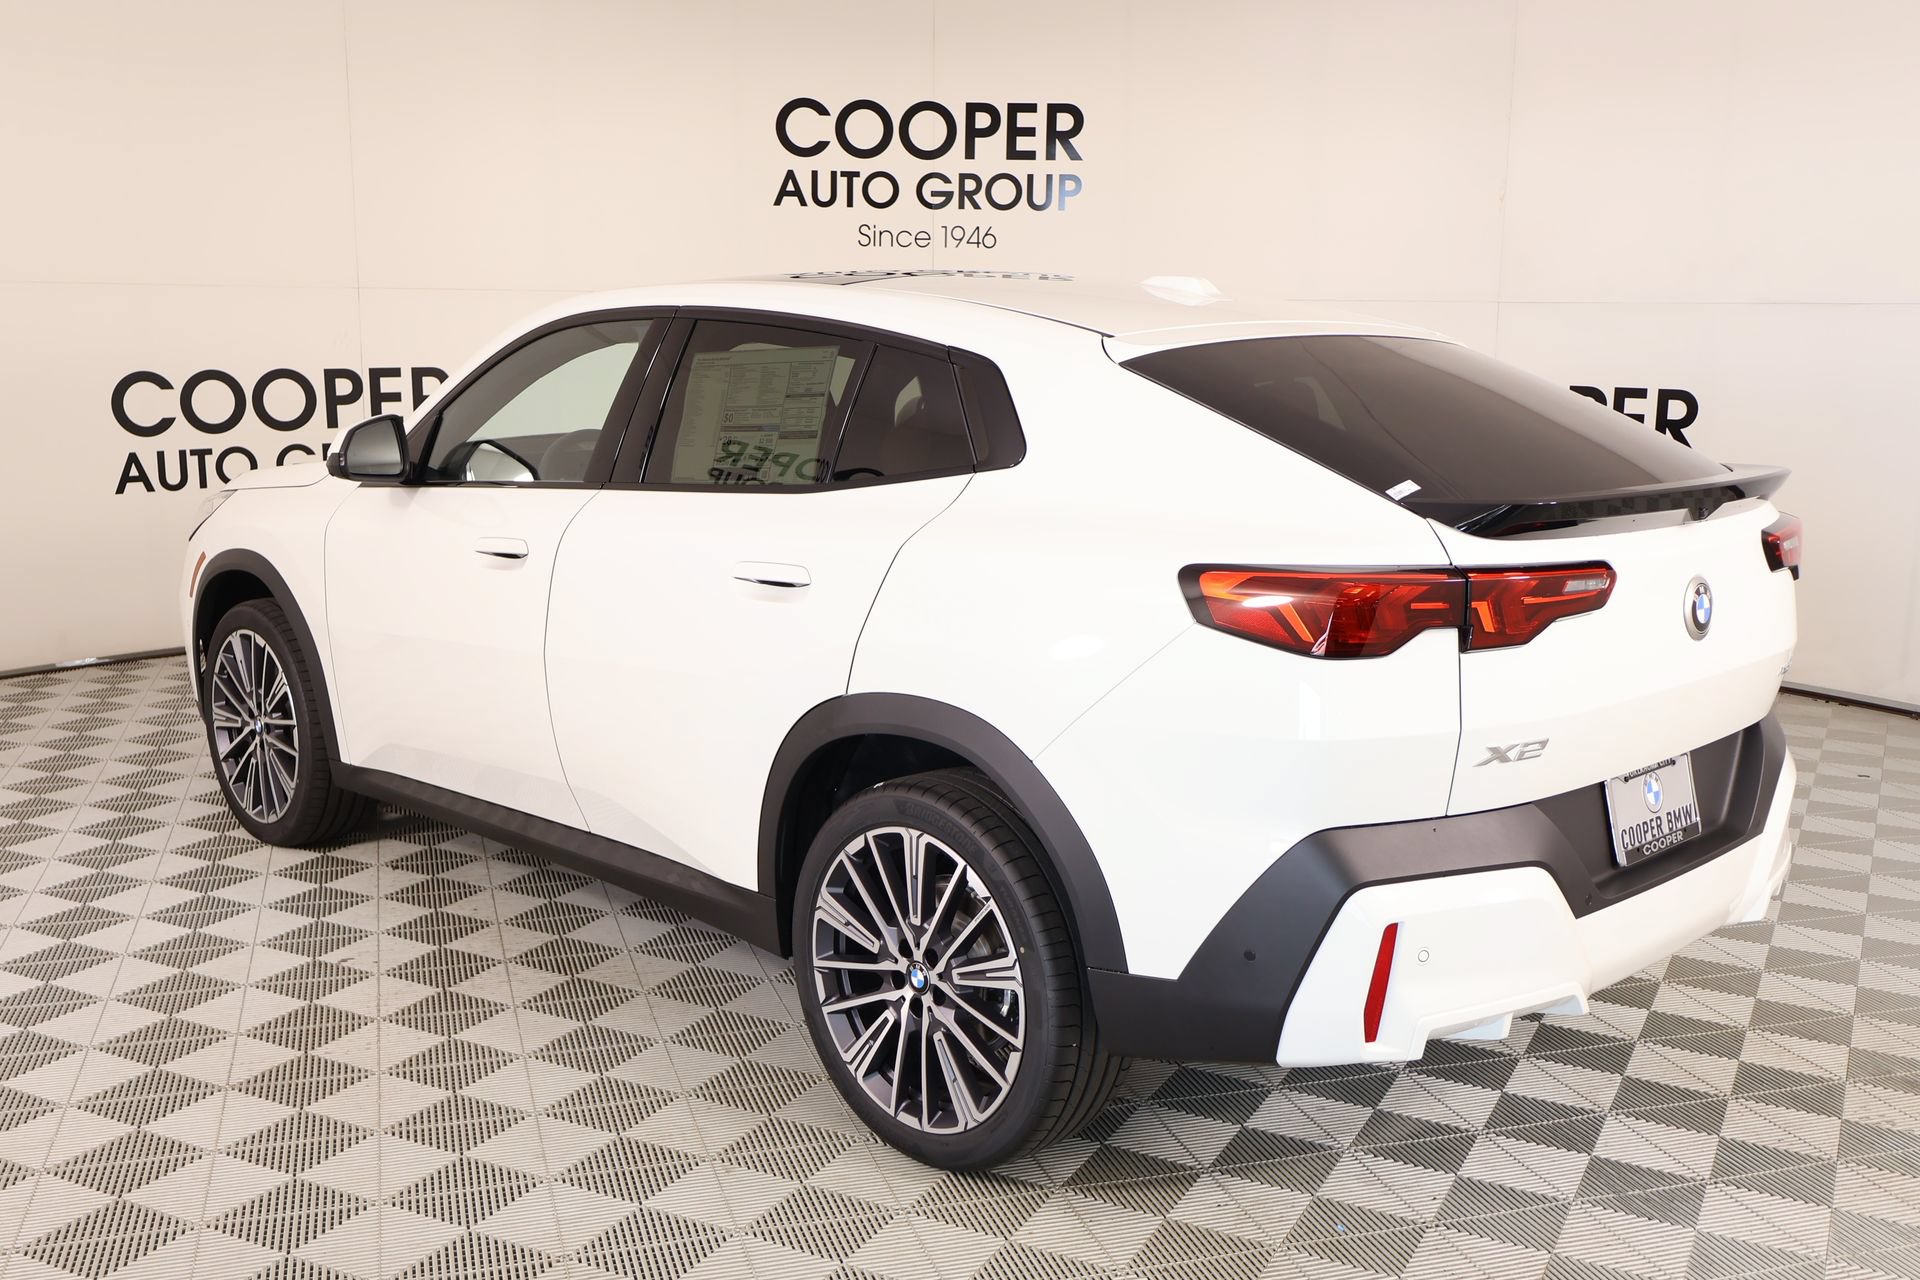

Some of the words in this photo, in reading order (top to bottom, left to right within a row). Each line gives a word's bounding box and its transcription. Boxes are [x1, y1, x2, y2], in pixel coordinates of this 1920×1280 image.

[775, 97, 1085, 161] COOPER
[773, 169, 900, 210] AUTO
[916, 172, 1083, 211] GROUP
[858, 224, 931, 248] Since
[941, 226, 997, 249] 1946
[1472, 738, 1549, 767] X2
[1621, 815, 1664, 850] COOPER
[1666, 803, 1692, 833] BMW
[1642, 830, 1684, 855] COOPER
